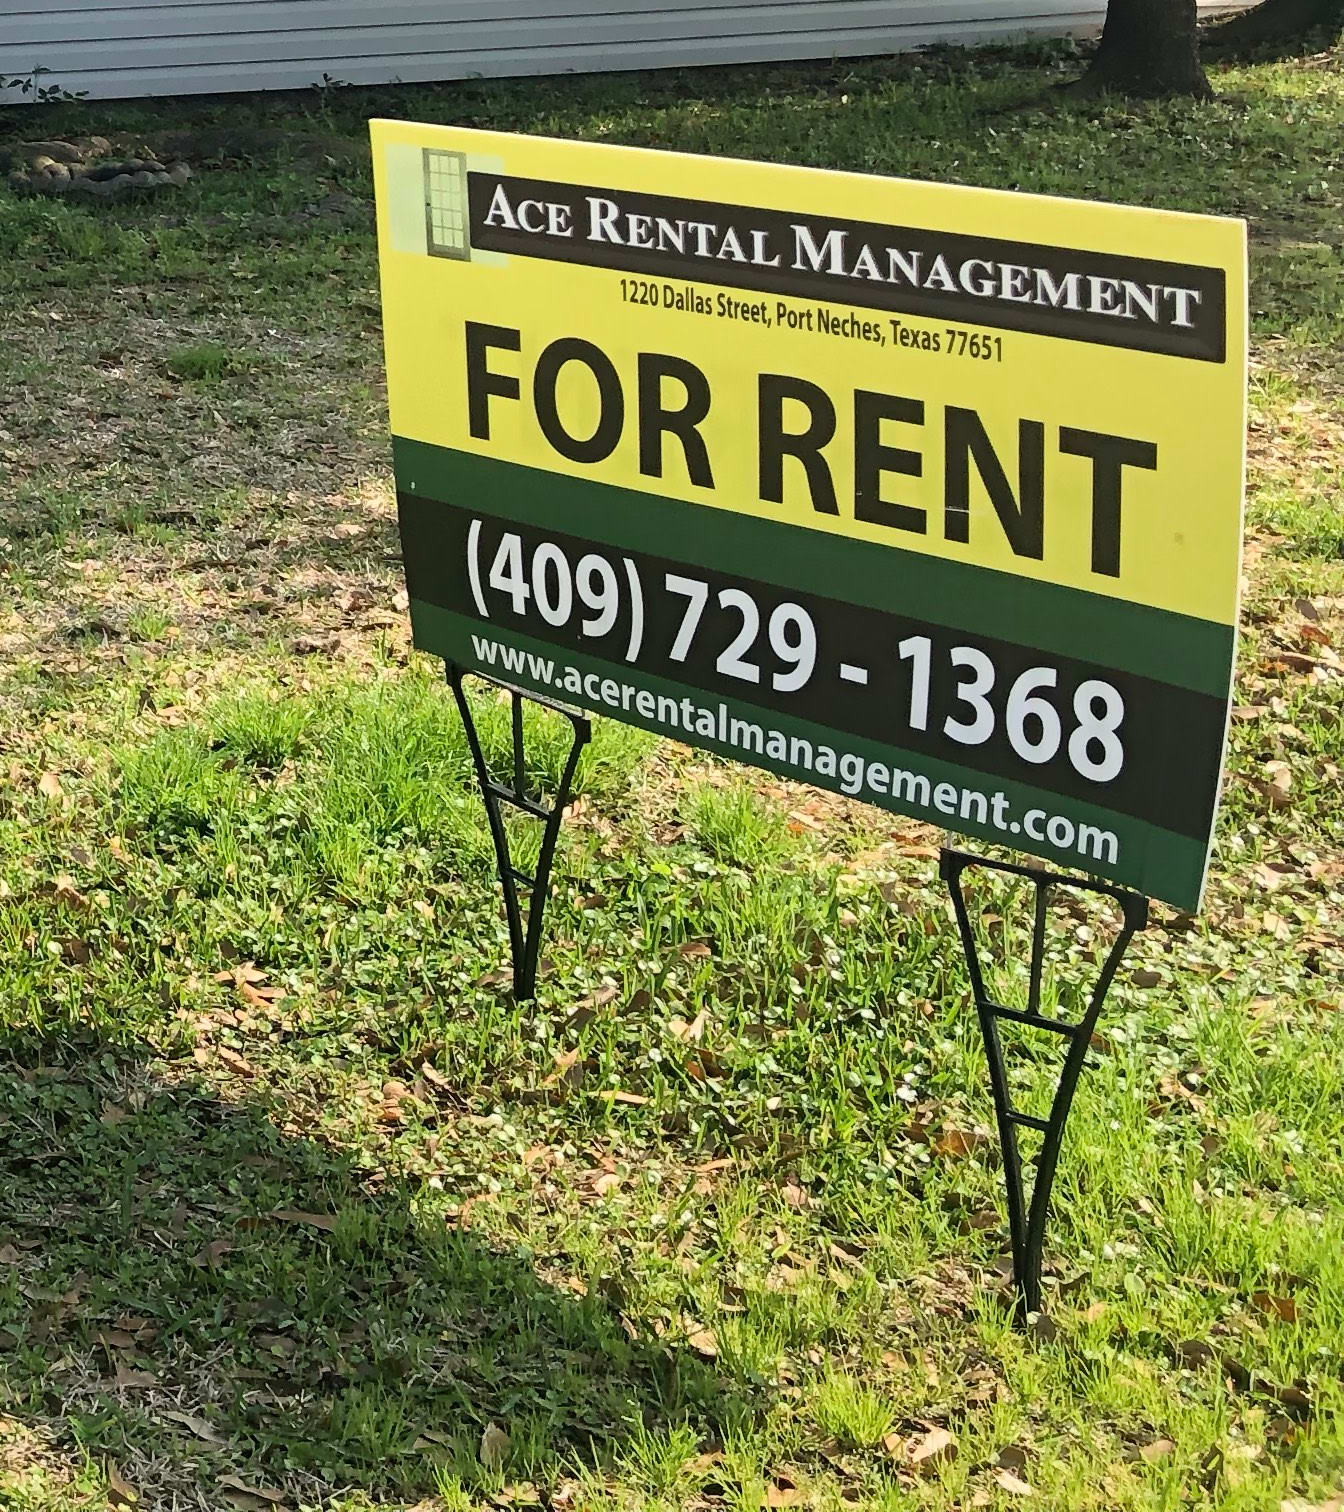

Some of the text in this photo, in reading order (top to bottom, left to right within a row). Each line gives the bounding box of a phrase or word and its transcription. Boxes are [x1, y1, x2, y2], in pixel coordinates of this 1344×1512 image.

[619, 278, 1003, 363] 1220 Dallas Street, Port Neches, Texas 77651
[464, 320, 1158, 579] FOR RENT
[467, 519, 644, 662] (409)
[664, 572, 817, 692] 729
[898, 635, 1125, 783] 1368
[470, 634, 1119, 865] www.acerentalmanagement.com
